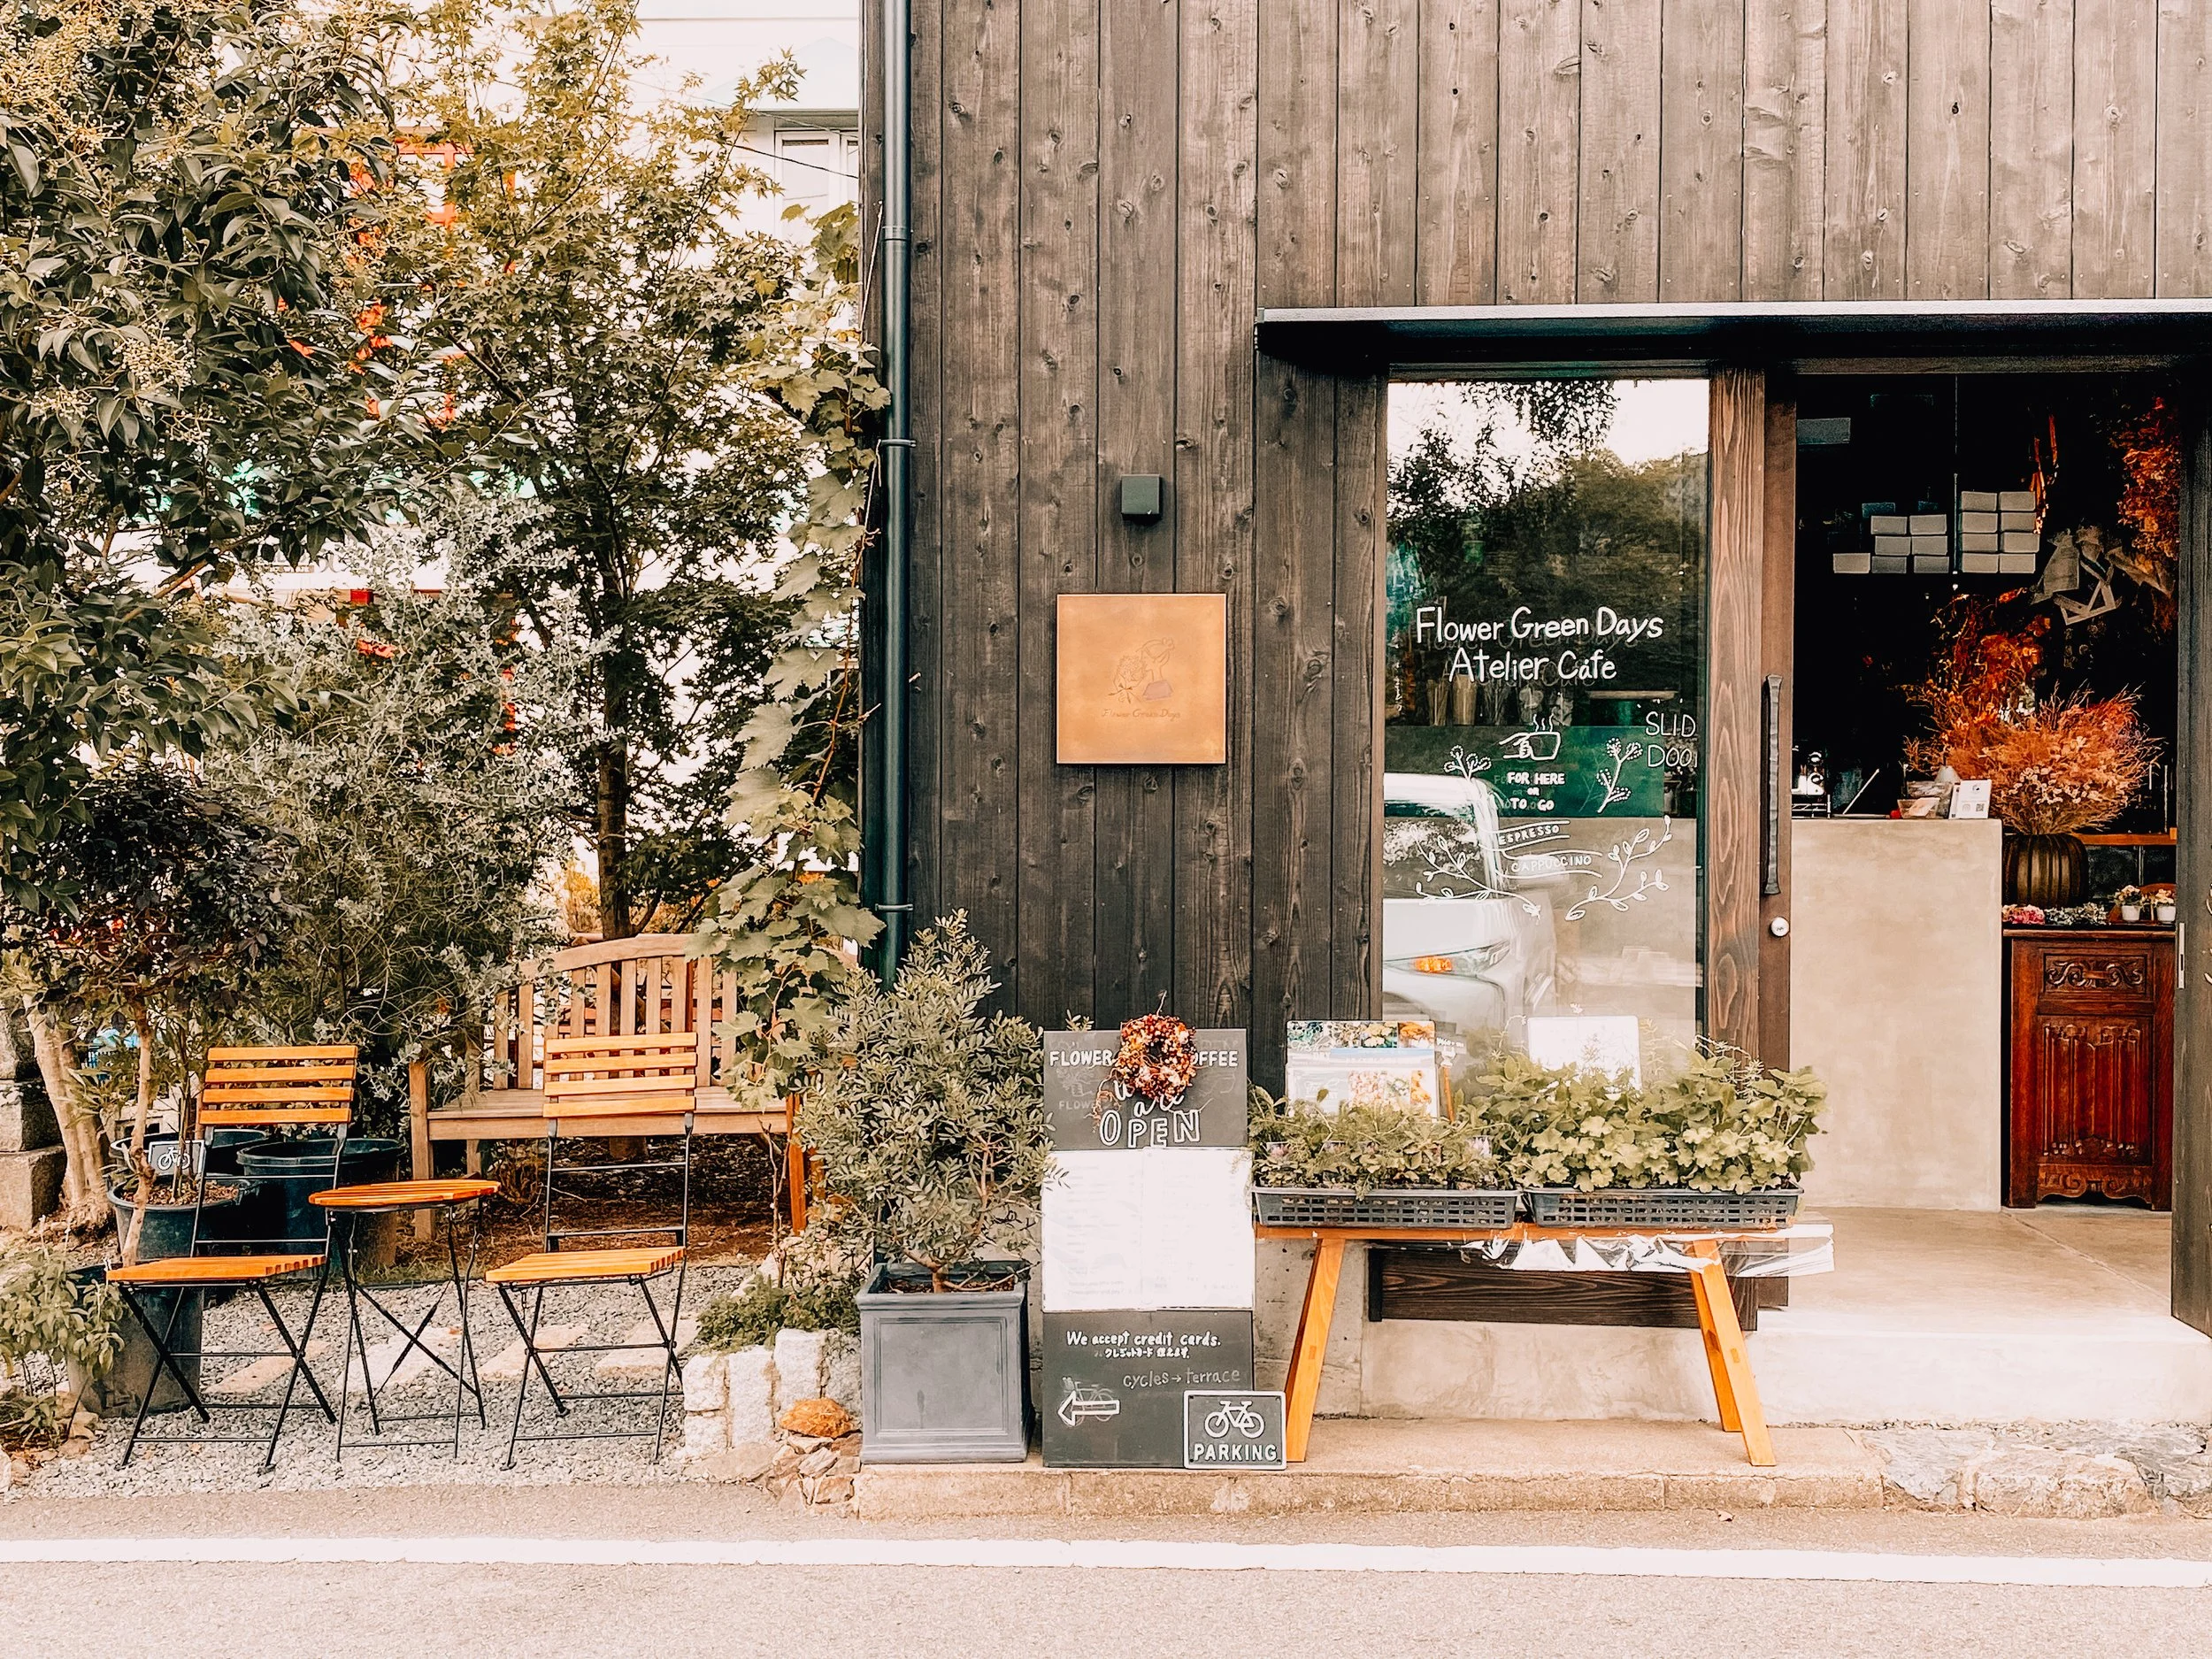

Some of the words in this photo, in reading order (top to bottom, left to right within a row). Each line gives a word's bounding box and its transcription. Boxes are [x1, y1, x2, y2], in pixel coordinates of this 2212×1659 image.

[1416, 606, 1504, 643] Flower
[1510, 606, 1589, 639] Green
[1597, 606, 1664, 642] Days
[1448, 647, 1550, 682] Atelier
[1557, 649, 1617, 680] Cafe
[1506, 772, 1531, 785] FOR
[1533, 772, 1565, 785] HERE
[1526, 787, 1540, 796] OR
[1509, 797, 1527, 810] TO
[1537, 799, 1555, 811] GO
[1498, 825, 1560, 845] ESPRESSO
[1510, 856, 1593, 873] CAPPUCCINO
[1049, 1048, 1113, 1067] FLOWER
[1099, 1109, 1201, 1148] OPEN
[1066, 1331, 1087, 1346] We
[1092, 1330, 1130, 1347] accept
[1133, 1331, 1173, 1346] credit
[1179, 1331, 1221, 1346] cards.
[1123, 1370, 1169, 1389] cycles
[1185, 1367, 1240, 1385] terrace
[1194, 1443, 1277, 1462] PARKING
